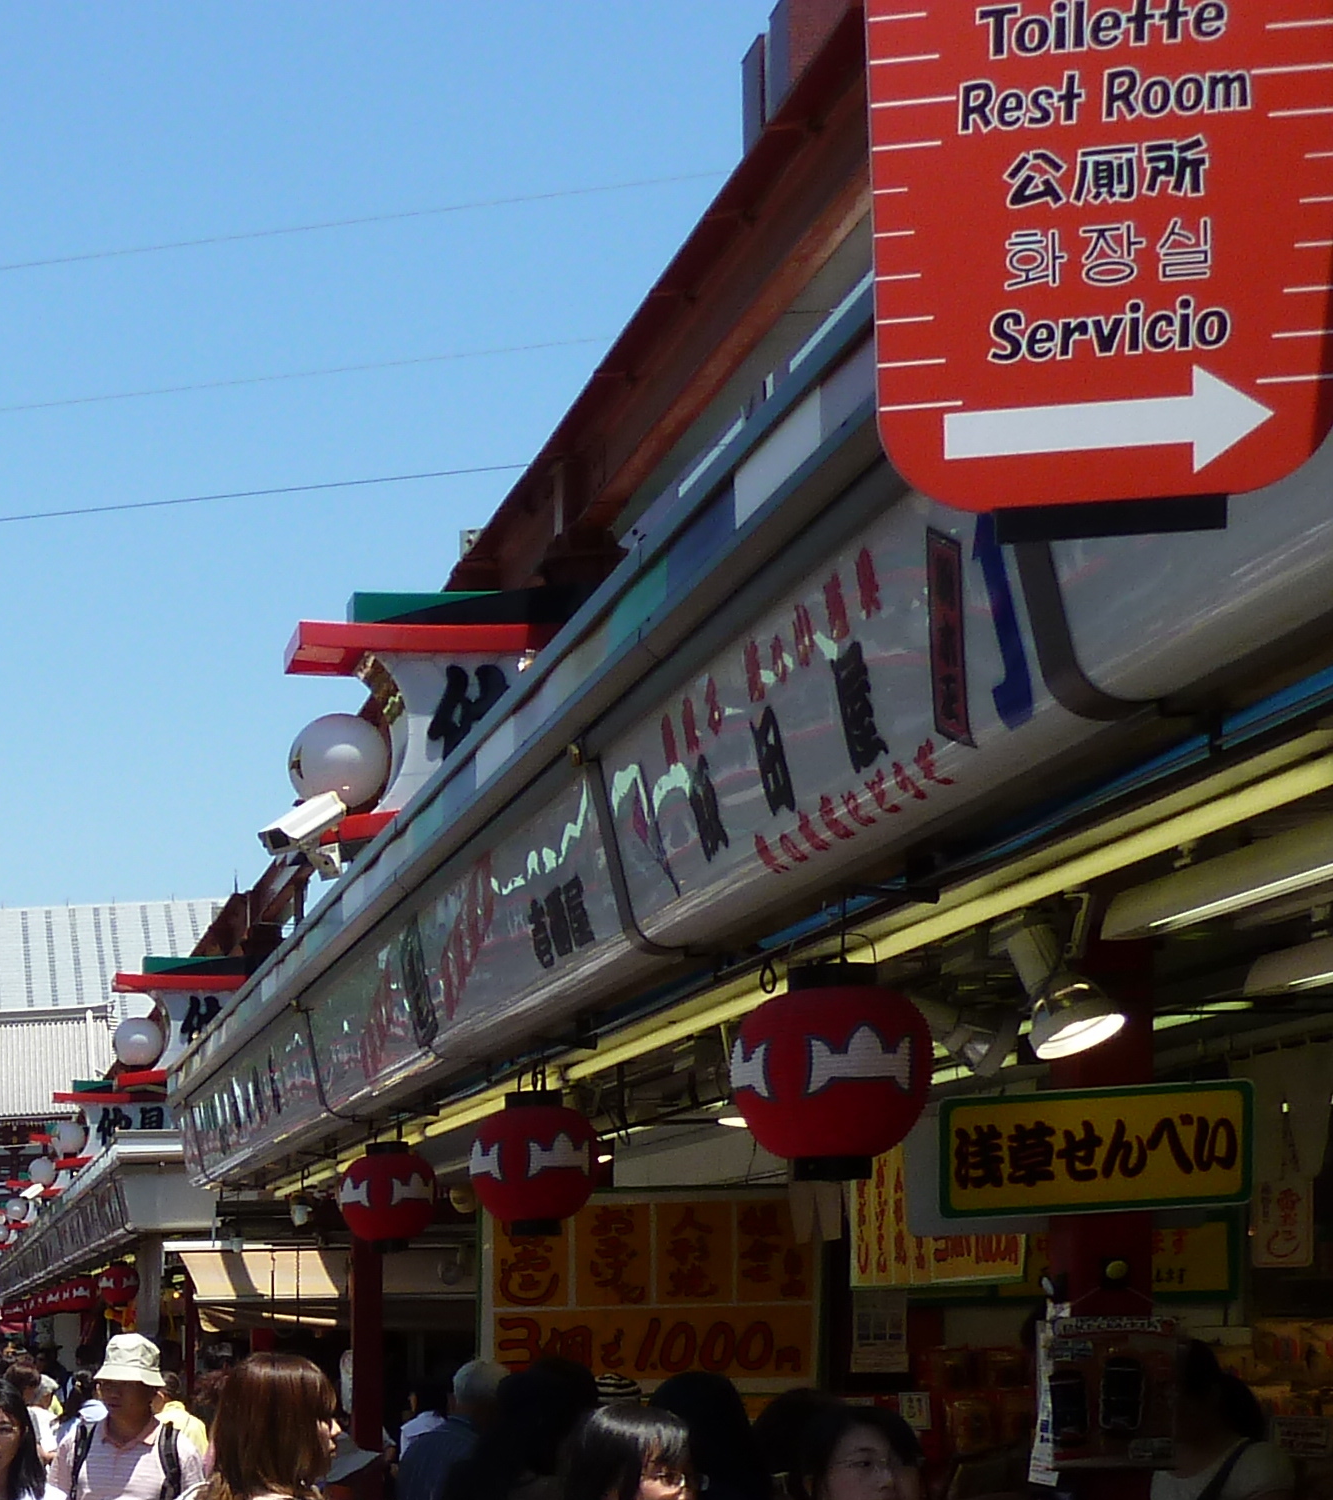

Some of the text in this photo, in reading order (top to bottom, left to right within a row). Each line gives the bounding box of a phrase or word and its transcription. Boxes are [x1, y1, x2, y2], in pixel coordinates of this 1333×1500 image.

[976, 0, 1227, 59] Toilette
[958, 67, 1251, 134] Rest Room
[1004, 217, 1212, 290] 화장실
[987, 295, 1230, 363] Servicio
[954, 1112, 1238, 1191] 浅草せんべい
